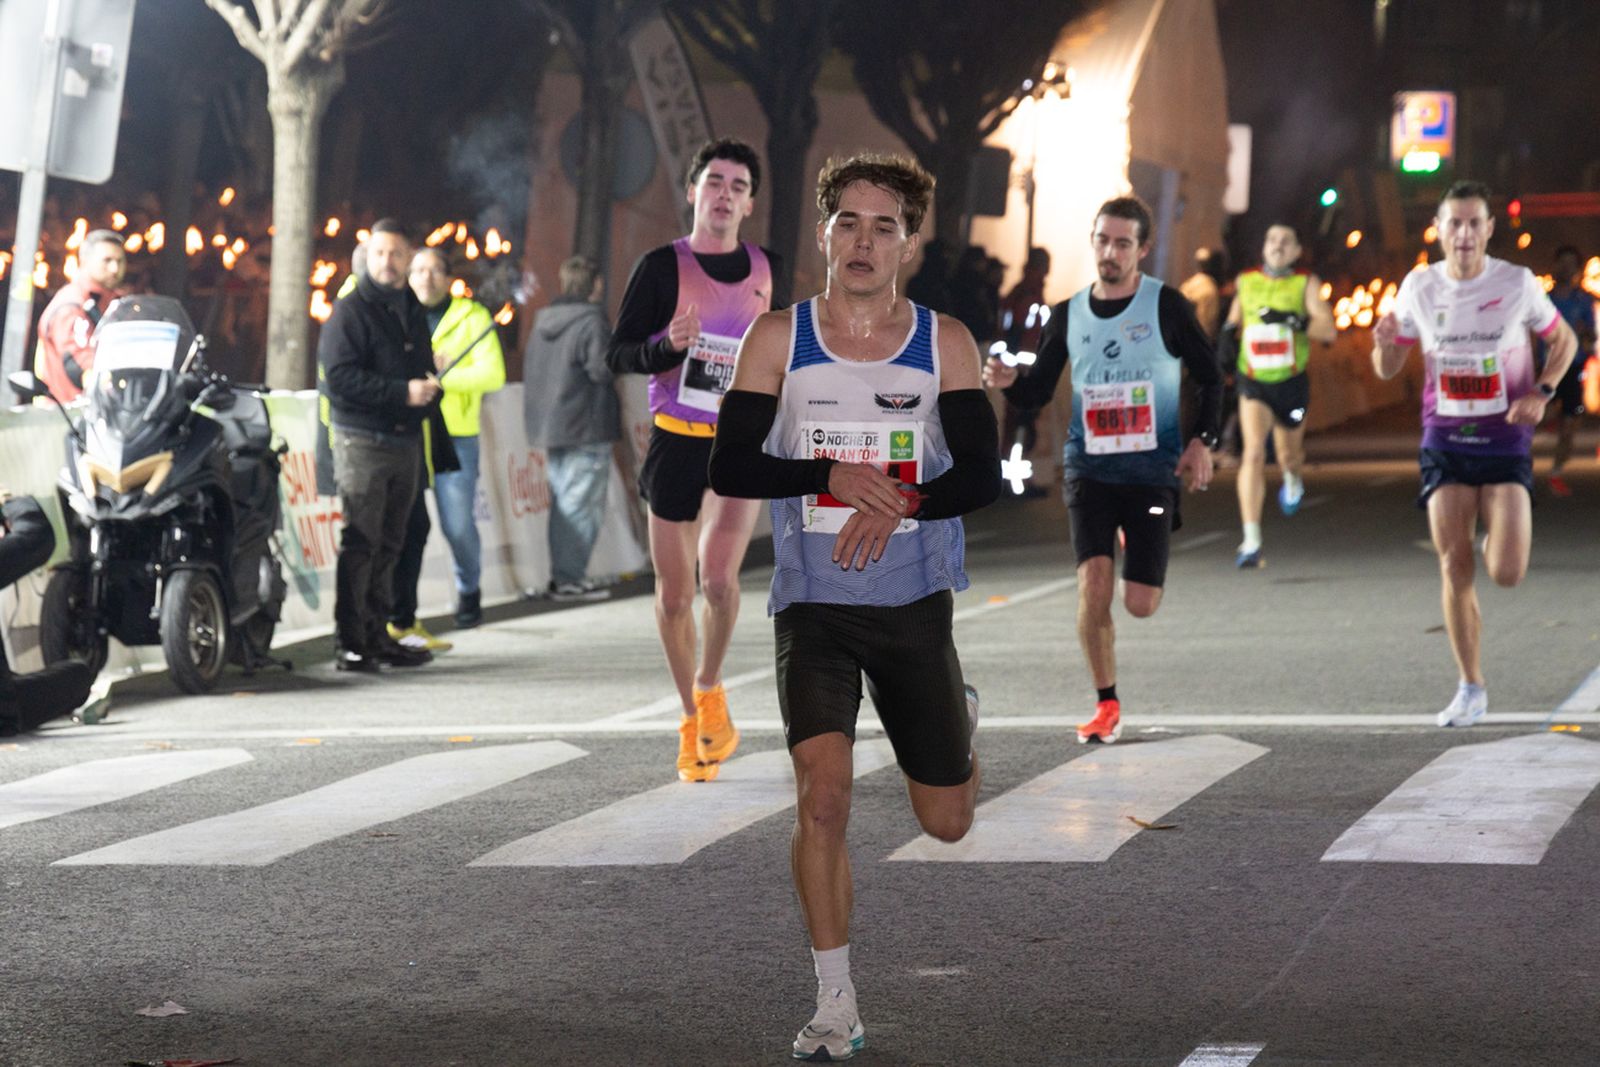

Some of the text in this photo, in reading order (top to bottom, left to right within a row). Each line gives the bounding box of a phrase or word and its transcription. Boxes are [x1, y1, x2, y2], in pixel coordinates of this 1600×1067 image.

[714, 354, 736, 365] ANTÓ
[704, 362, 734, 377] Gait
[1097, 406, 1138, 429] 6817
[827, 435, 879, 447] NOCHE DE
[814, 448, 836, 460] SAN
[839, 446, 879, 460] ANTÓN
